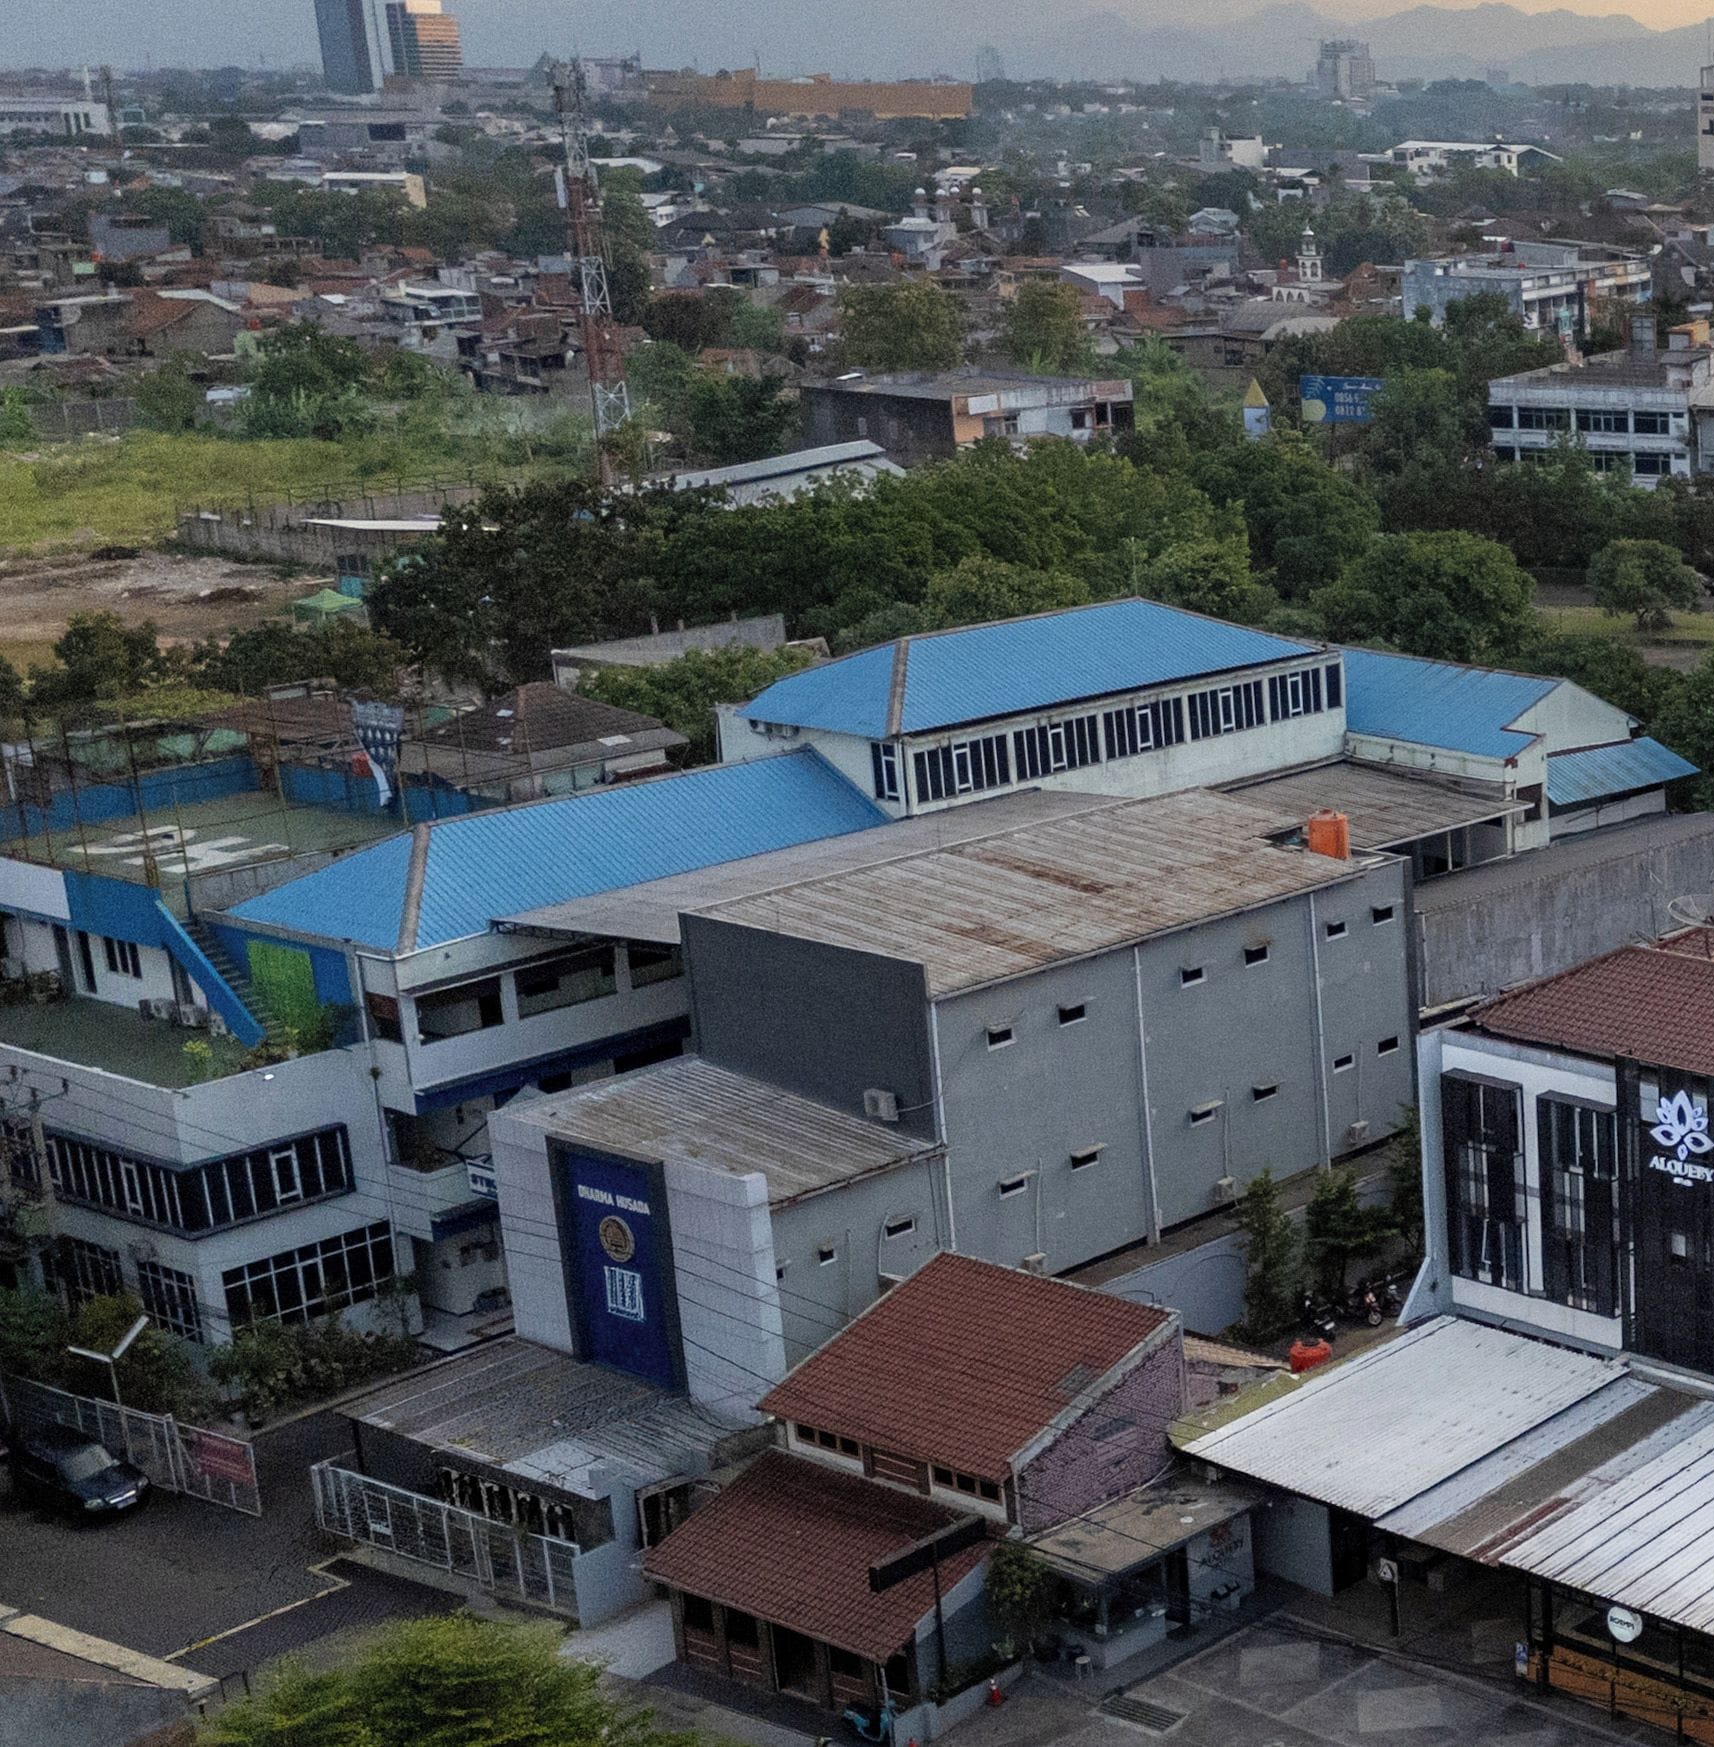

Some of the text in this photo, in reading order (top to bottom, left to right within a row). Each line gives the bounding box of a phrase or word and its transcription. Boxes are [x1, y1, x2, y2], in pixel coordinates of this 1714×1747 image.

[1649, 1155, 1714, 1182] ALQUEBY
[578, 1184, 652, 1215] DHARMA HUSADA
